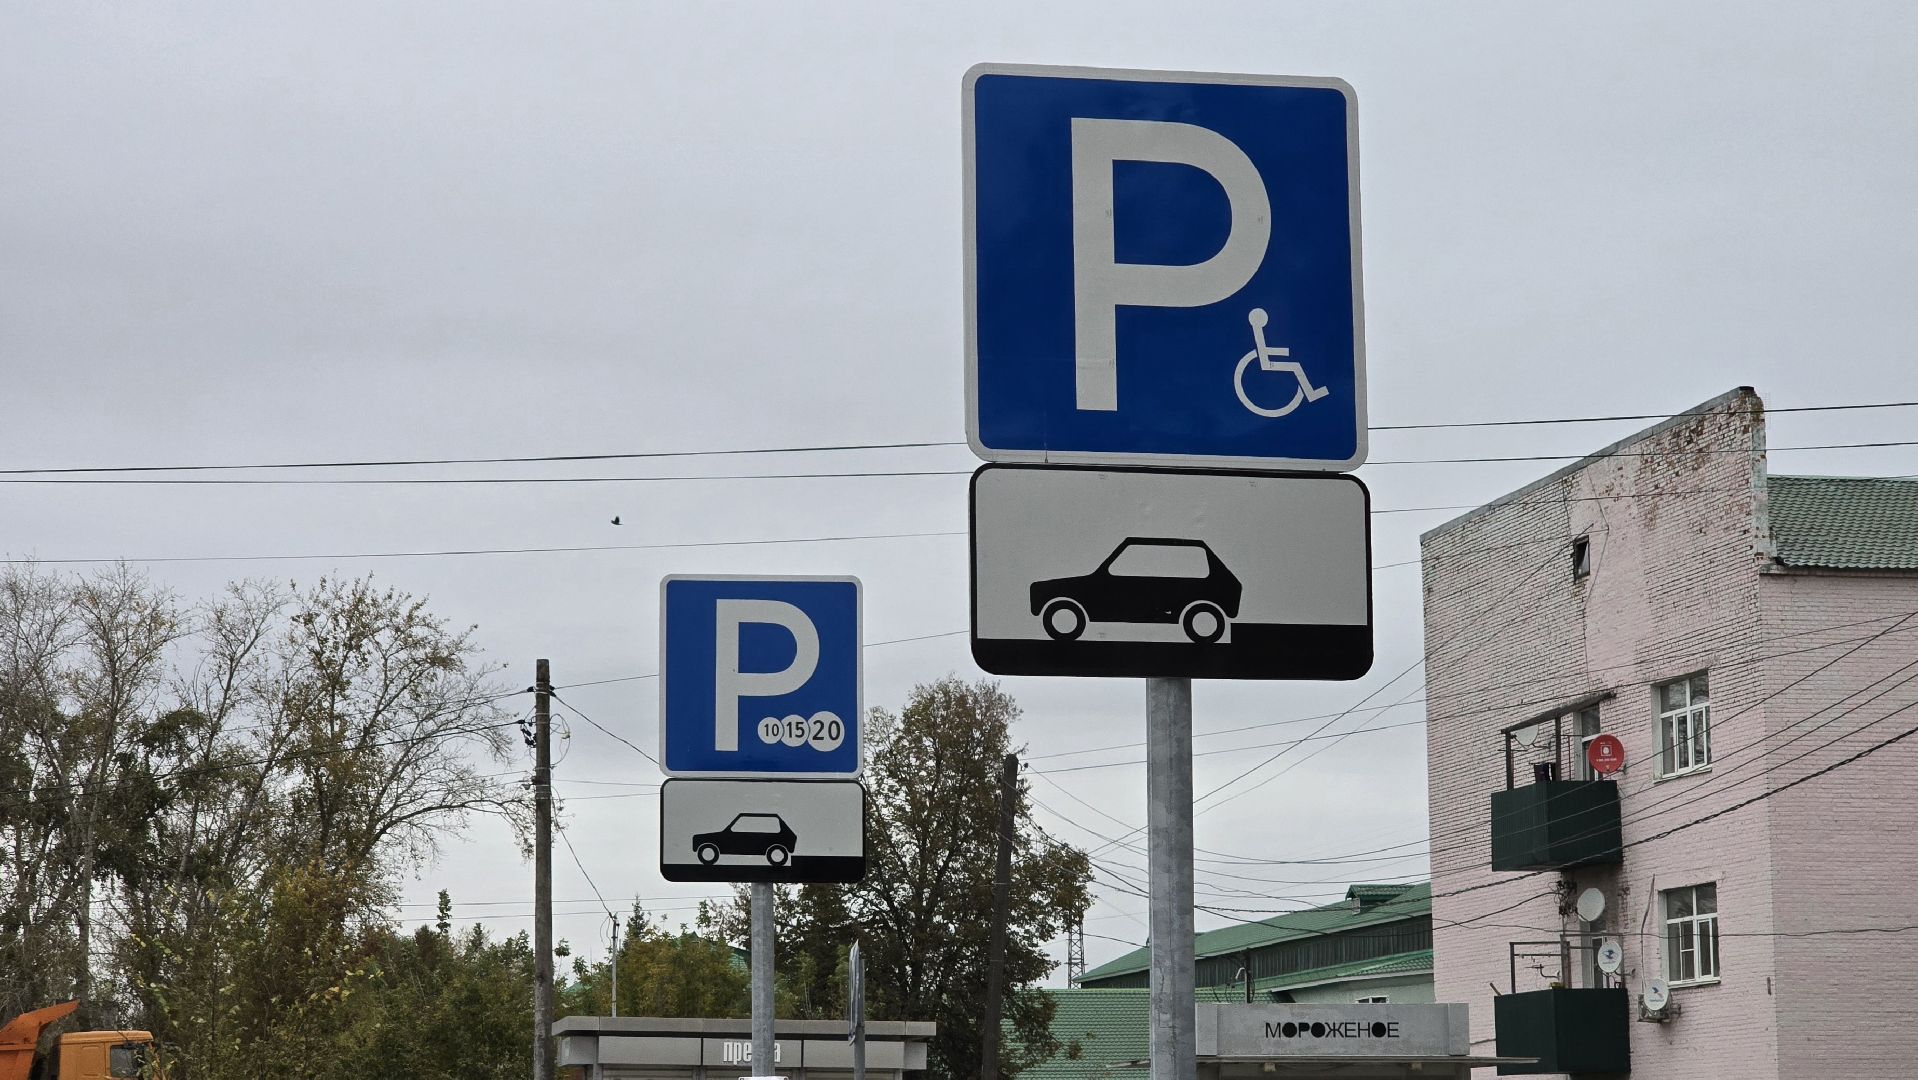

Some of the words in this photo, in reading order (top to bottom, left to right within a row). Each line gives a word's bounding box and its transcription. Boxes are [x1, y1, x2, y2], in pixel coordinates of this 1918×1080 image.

[1071, 117, 1272, 411] P
[715, 598, 820, 751] P
[764, 723, 780, 737] 10
[786, 721, 805, 738] 15
[812, 719, 841, 741] 20
[1265, 1021, 1400, 1038] МОРОЖЕНОЕ
[723, 1041, 781, 1065] преа
